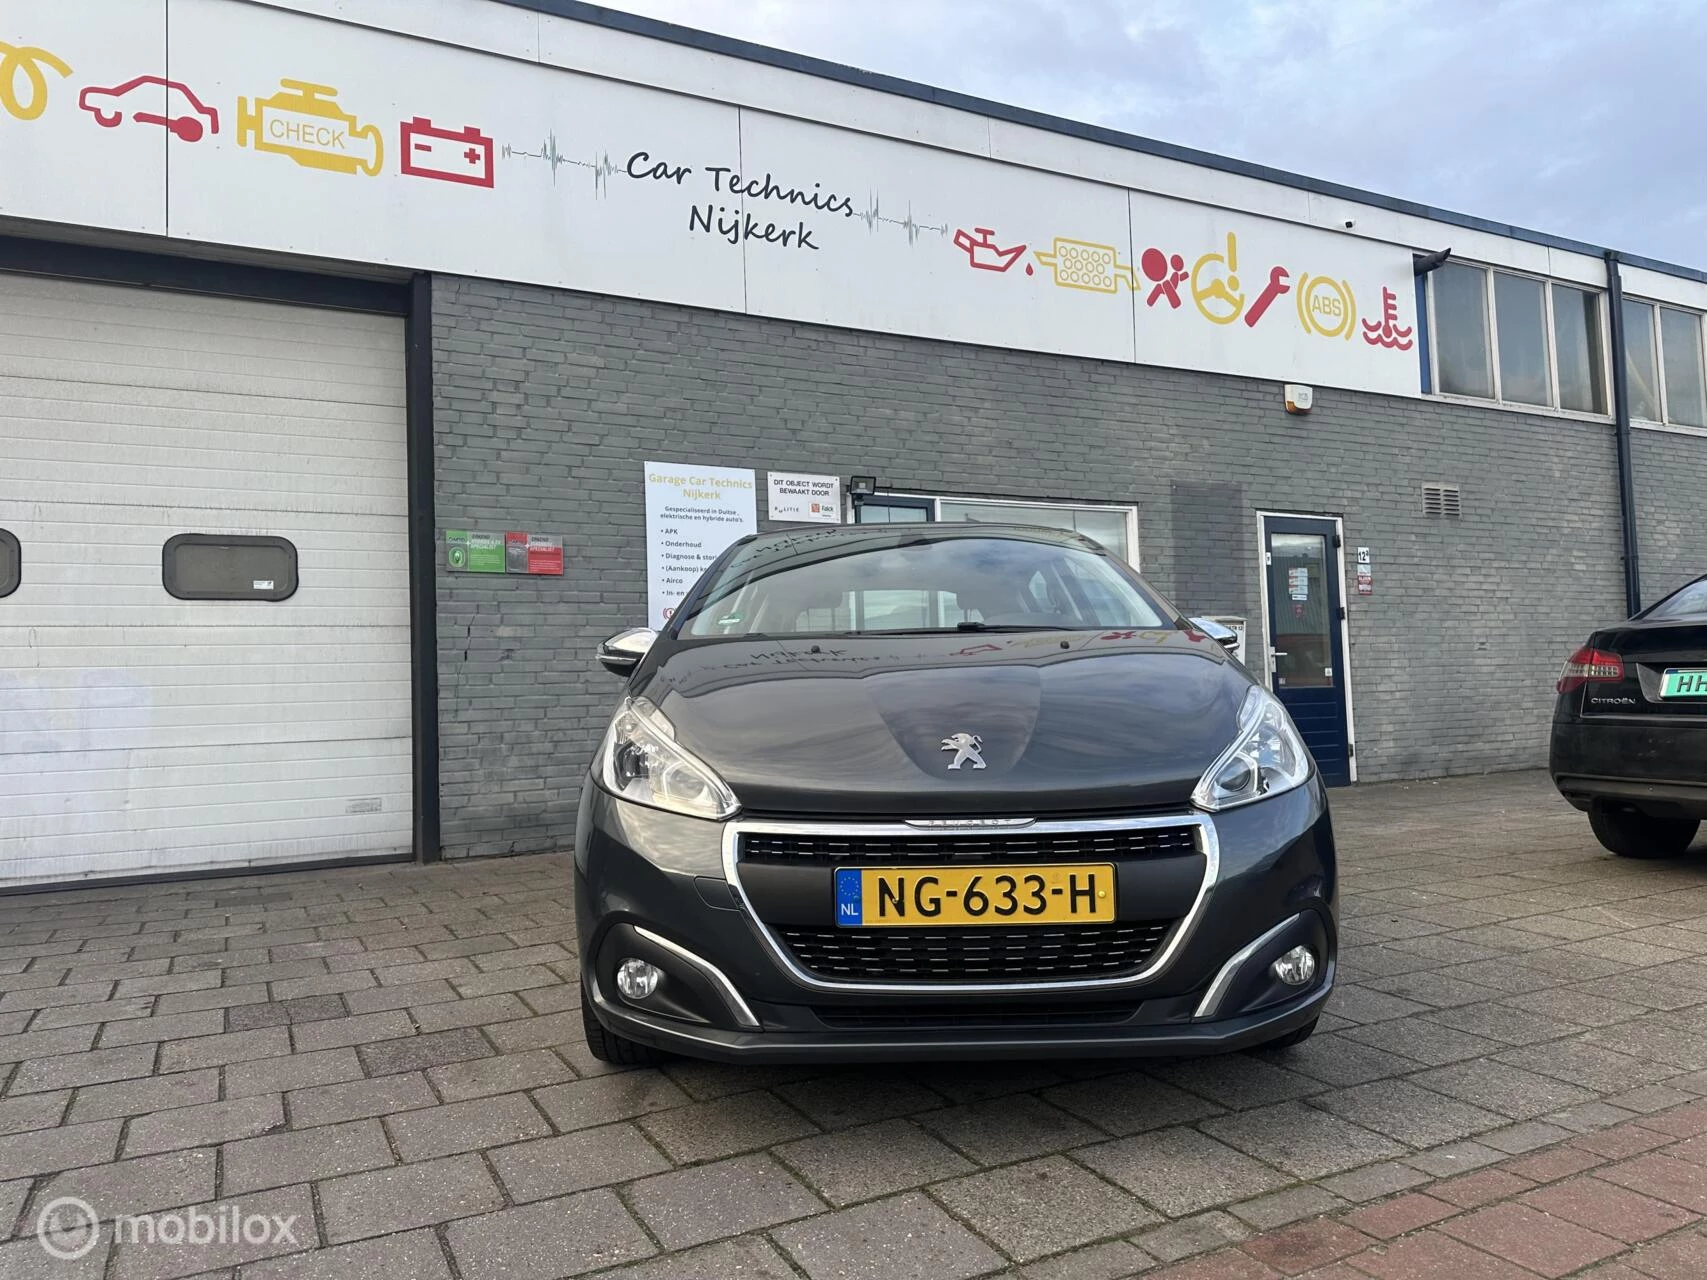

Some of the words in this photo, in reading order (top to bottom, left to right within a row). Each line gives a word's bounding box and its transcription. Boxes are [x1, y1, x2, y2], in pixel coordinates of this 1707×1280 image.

[269, 119, 345, 149] CHECK
[626, 152, 692, 184] Car
[705, 167, 853, 217] Technics
[689, 204, 819, 250] Nijkerk
[1312, 294, 1342, 317] ABS
[649, 474, 686, 486] Garage
[688, 476, 706, 486] Car
[709, 478, 752, 489] Technics
[683, 489, 721, 500] Nijkerk
[779, 487, 810, 495] BEWAAKT
[665, 506, 710, 515] Gespecialiseerd
[702, 515, 725, 523] hybride
[665, 553, 696, 561] Diagnose
[665, 565, 699, 573] (Aankoop)
[1590, 697, 1636, 705] CITROËN
[841, 903, 859, 916] NL
[878, 873, 1097, 917] NG-633-H
